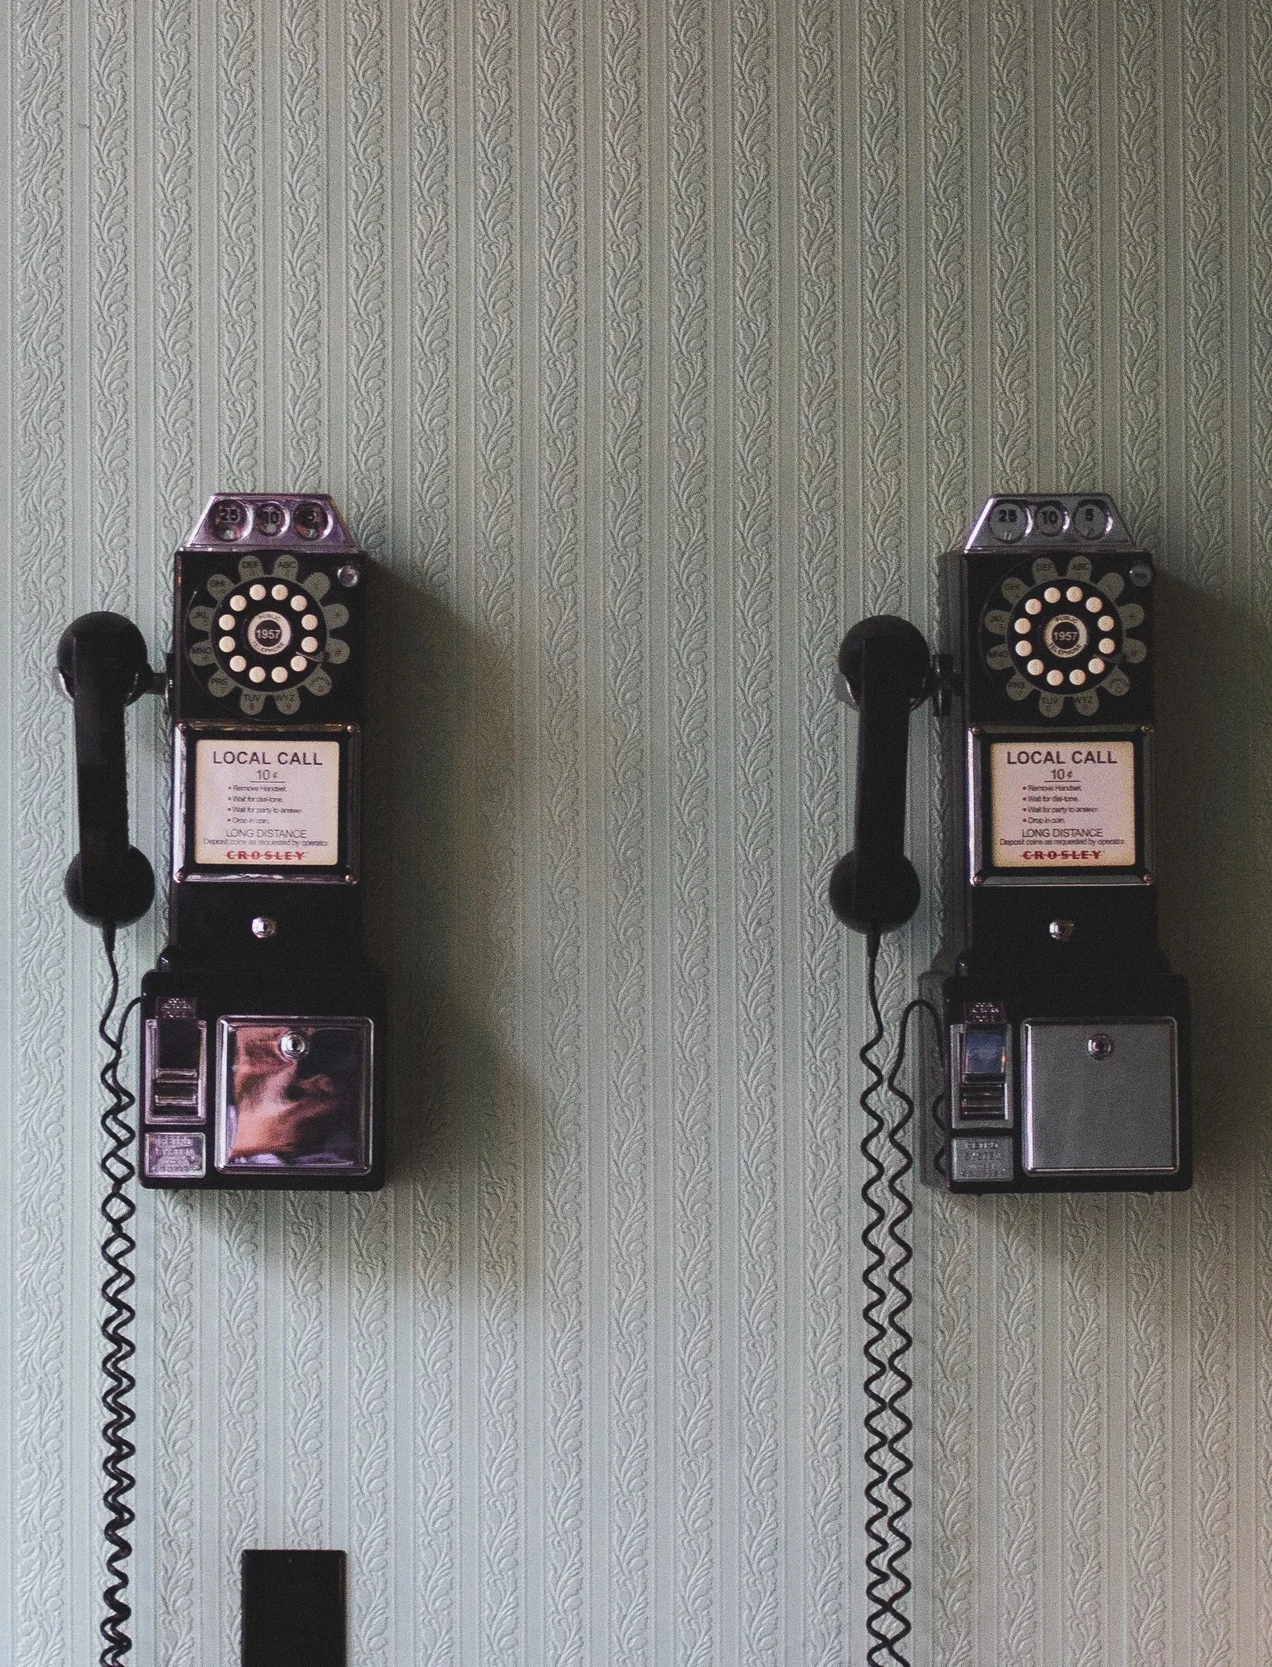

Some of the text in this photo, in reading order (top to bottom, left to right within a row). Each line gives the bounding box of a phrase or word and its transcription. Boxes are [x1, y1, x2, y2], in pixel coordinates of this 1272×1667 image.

[998, 508, 1094, 524] 25 10 5
[277, 561, 296, 569] ABC
[256, 629, 281, 639] 1957
[1053, 631, 1078, 641] 1957
[1049, 643, 1082, 656] TELEPHONE
[213, 751, 323, 765] LOCAL CALL
[1007, 751, 1118, 765] LOCAL CALL
[256, 807, 272, 815] party
[226, 828, 307, 838] LONG DISTANCE
[1022, 828, 1103, 838] LONG DISTANCE
[292, 839, 300, 847] by
[1000, 838, 1025, 846] Deposit
[226, 850, 305, 860] CROSLEY
[1022, 850, 1102, 860] CROSLEY
